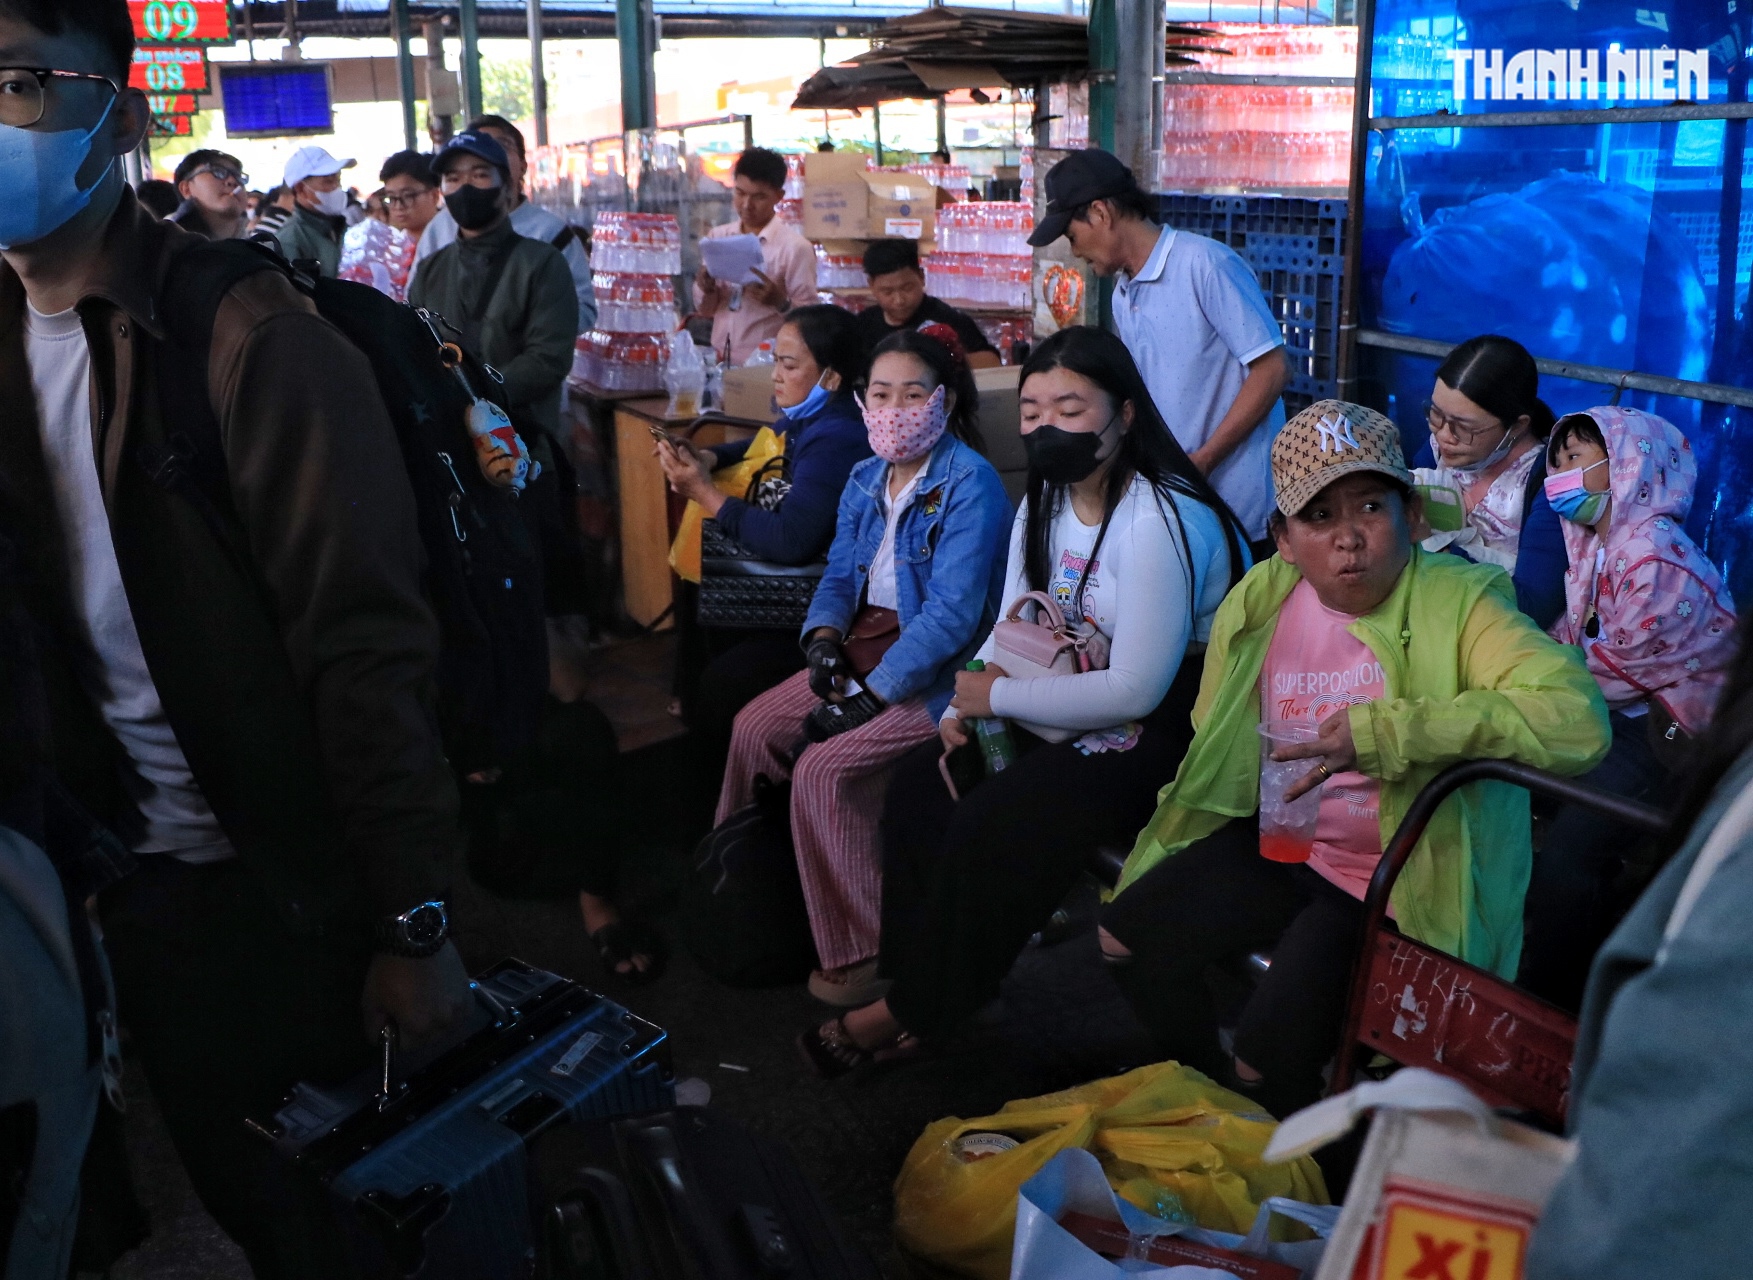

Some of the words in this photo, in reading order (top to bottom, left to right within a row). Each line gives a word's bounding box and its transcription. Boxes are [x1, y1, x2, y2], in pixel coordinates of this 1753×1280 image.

[143, 1, 198, 39] 09
[146, 63, 185, 91] 08
[1315, 412, 1360, 453] NY
[1614, 463, 1639, 475] baby
[1274, 661, 1385, 695] SUPERPOSION
